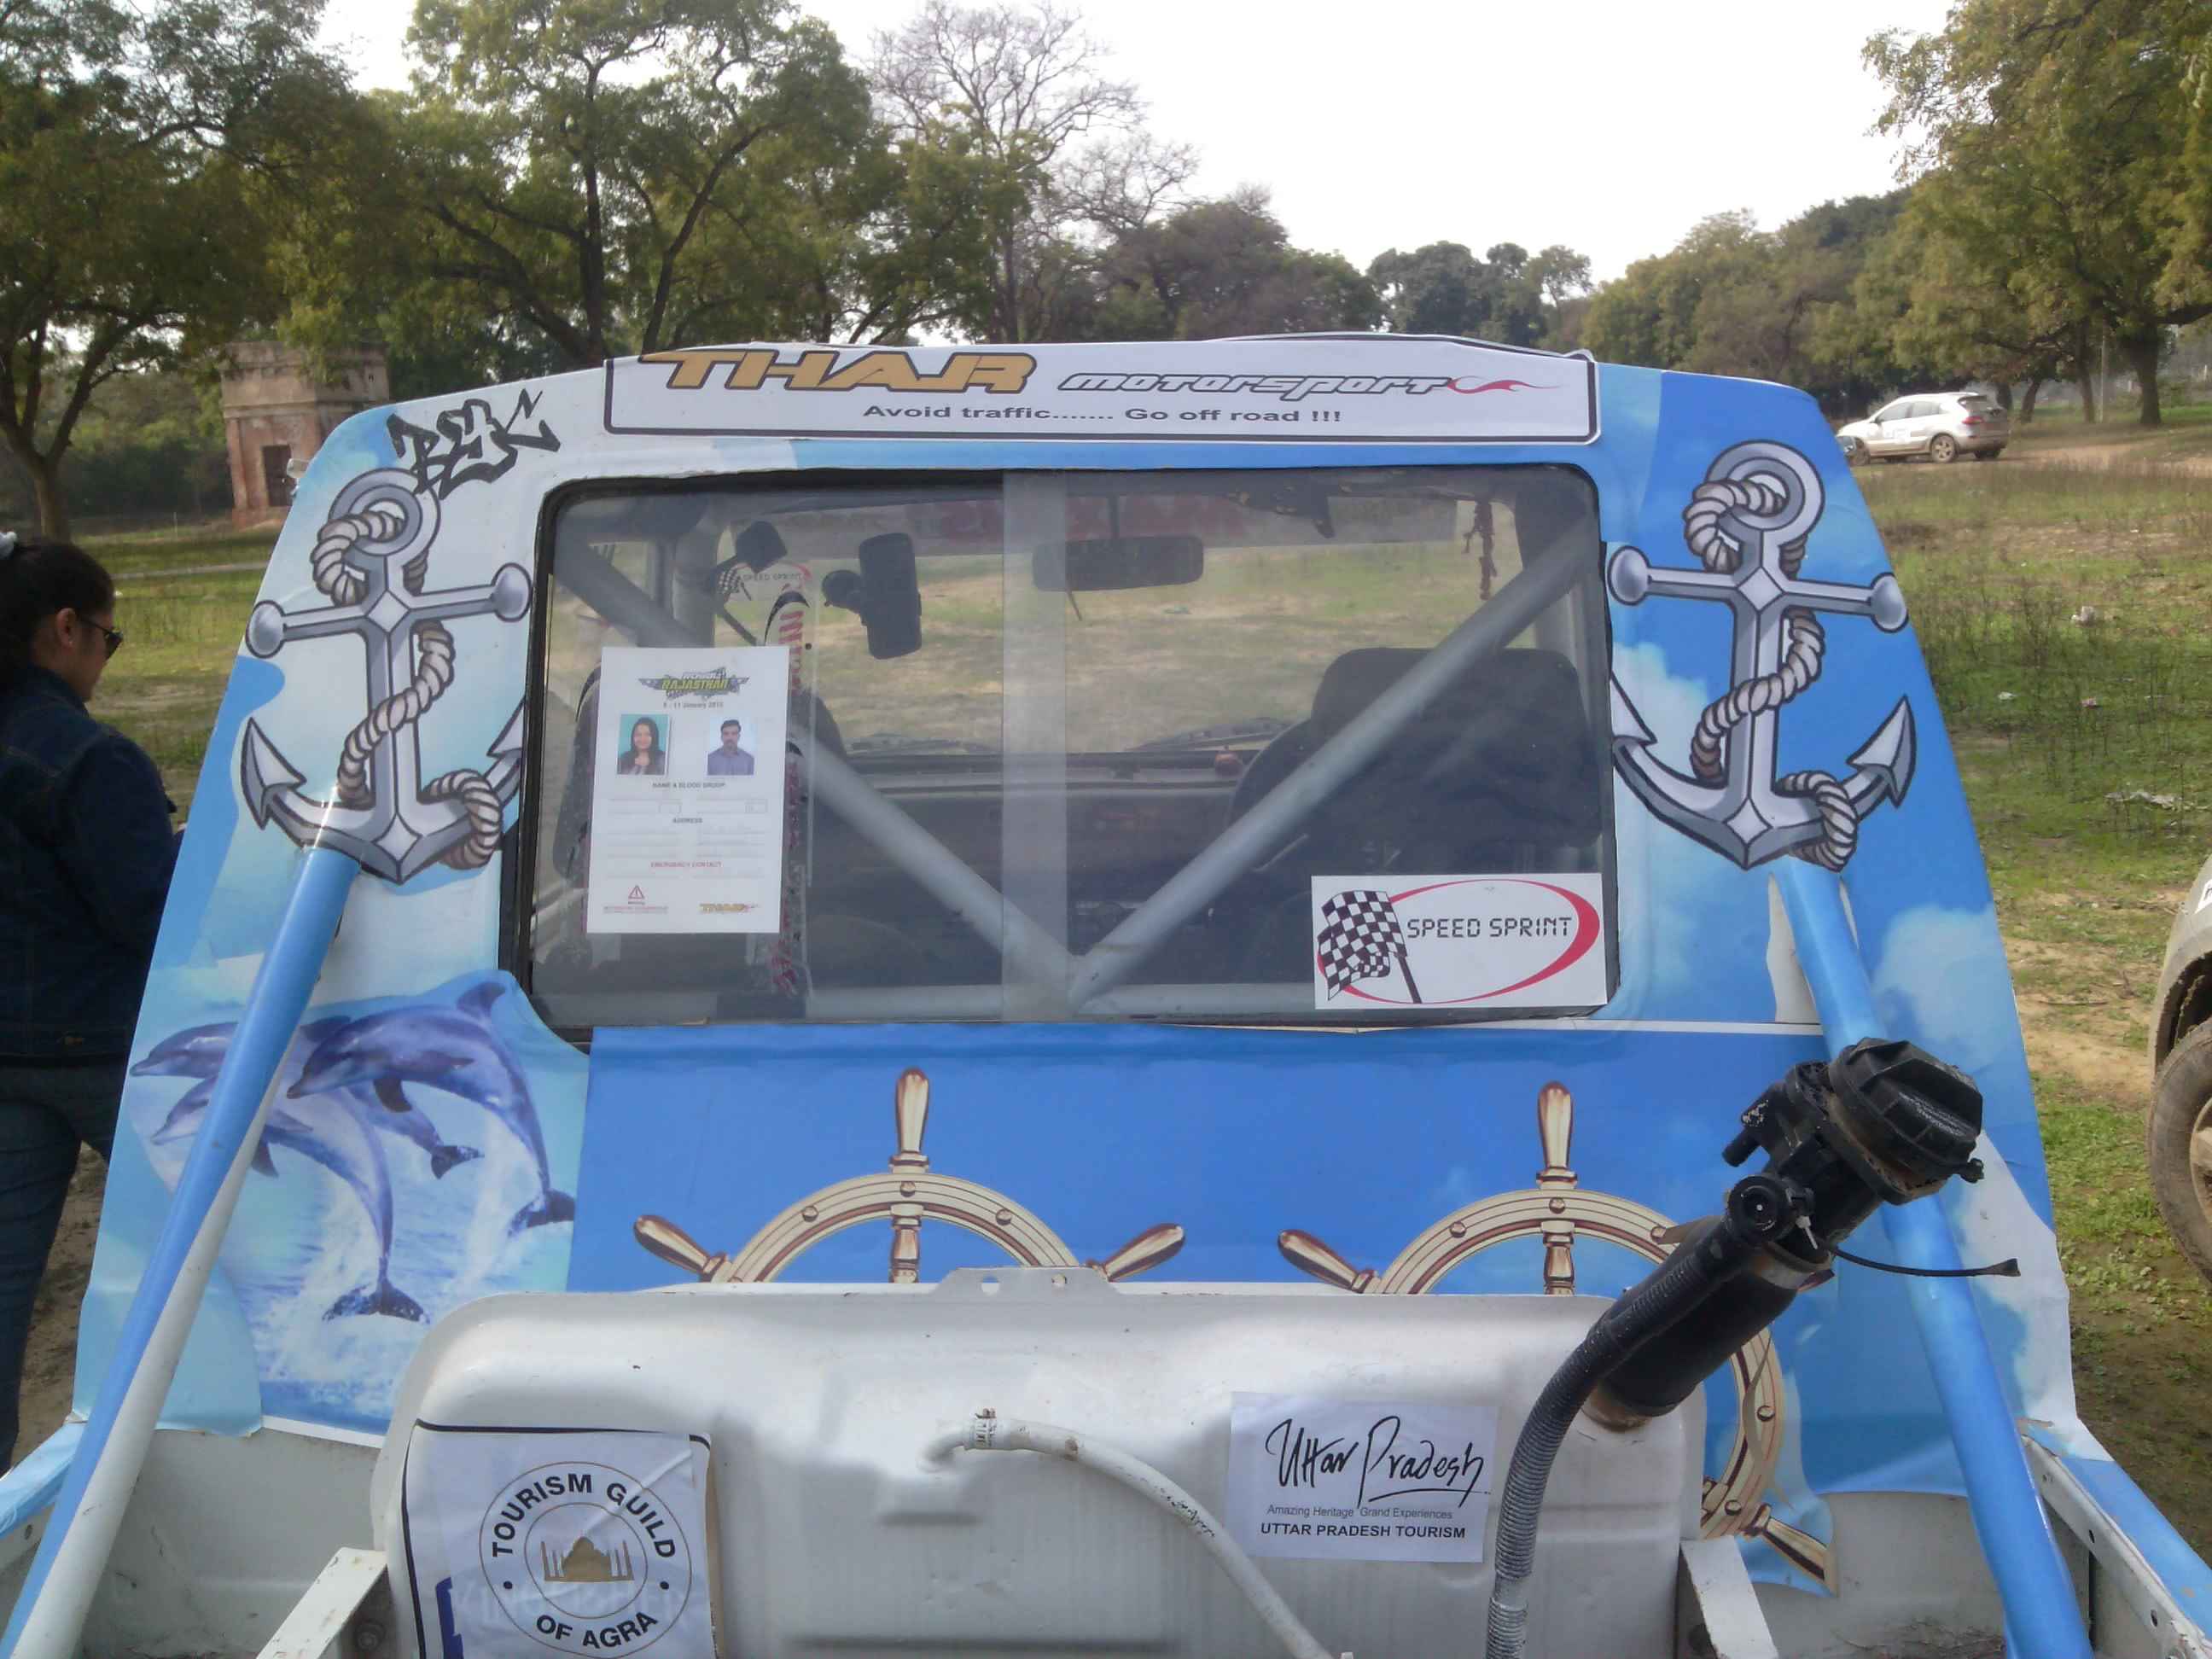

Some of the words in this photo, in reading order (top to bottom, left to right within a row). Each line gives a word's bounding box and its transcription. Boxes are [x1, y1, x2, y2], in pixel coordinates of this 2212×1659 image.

[637, 349, 1037, 394] THAR
[863, 405, 952, 418] Avoid
[1125, 409, 1169, 420] Go
[1179, 409, 1221, 421] off
[1231, 410, 1300, 422] road
[1408, 919, 1480, 938] SPEED
[1489, 917, 1572, 937] SPRINT
[1265, 1418, 1359, 1487] Uttar
[1357, 1416, 1484, 1508] Pradesh
[492, 1473, 592, 1557] TOURISM
[607, 1482, 676, 1557] GUILD
[1267, 1505, 1310, 1517] Amazing
[1313, 1507, 1353, 1519] Heritage
[1360, 1507, 1389, 1517] Grand
[1393, 1508, 1452, 1519] Experiences
[1261, 1522, 1311, 1535] UTTAR
[1317, 1525, 1390, 1537] PRADESH
[1395, 1526, 1465, 1539] TOURISM
[536, 1615, 573, 1640] OF
[582, 1611, 658, 1648] AGRA
